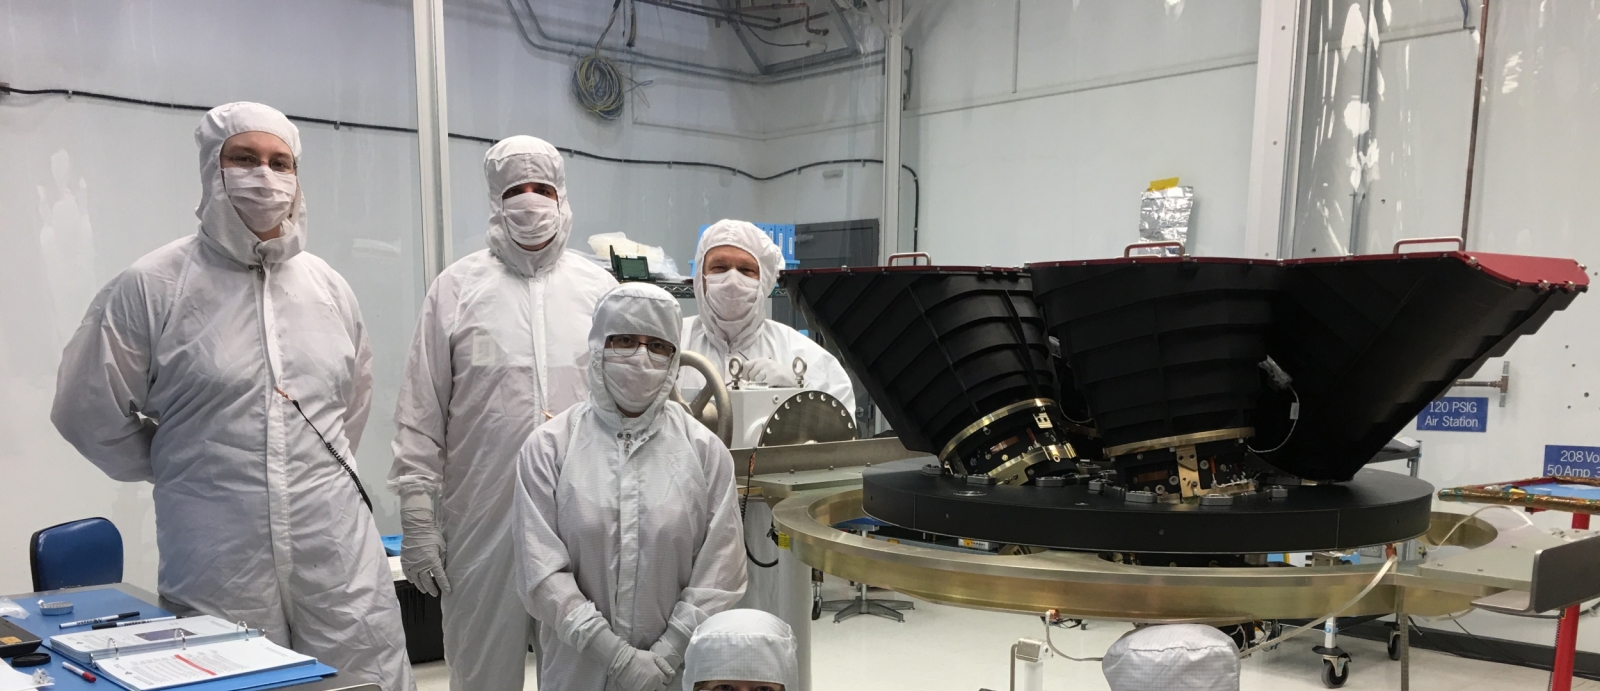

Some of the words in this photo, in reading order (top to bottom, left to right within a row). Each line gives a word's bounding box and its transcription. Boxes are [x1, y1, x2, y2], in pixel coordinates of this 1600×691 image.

[1429, 401, 1449, 413] 120
[1452, 401, 1477, 413] PSIG
[1424, 415, 1440, 426] Air
[1442, 415, 1479, 428] Station
[1560, 450, 1584, 463] 208
[1547, 464, 1563, 477] 50
[1563, 465, 1591, 478] Amp
